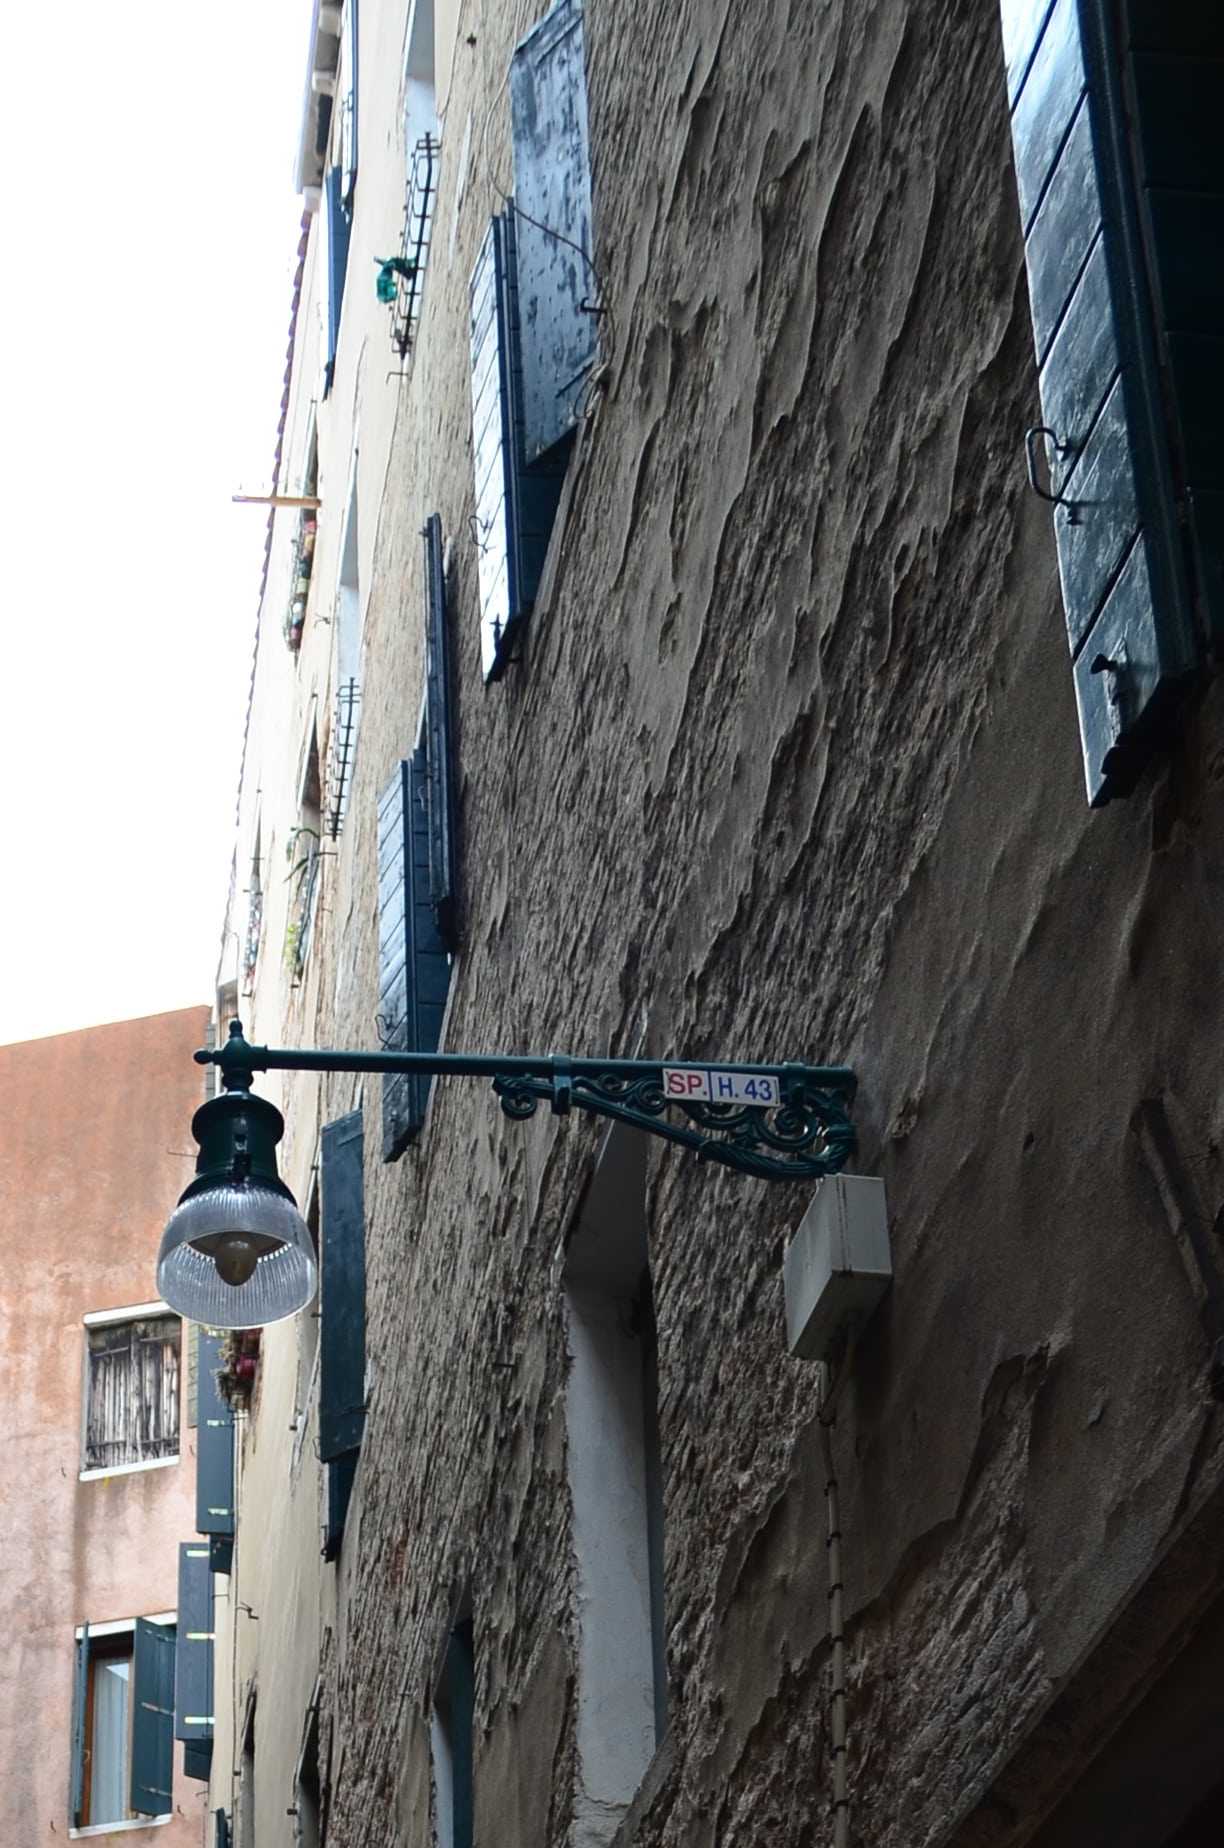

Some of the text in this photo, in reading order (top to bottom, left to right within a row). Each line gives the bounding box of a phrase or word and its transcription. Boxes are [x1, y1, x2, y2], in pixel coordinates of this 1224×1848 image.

[668, 1073, 772, 1100] SP. H. 43
